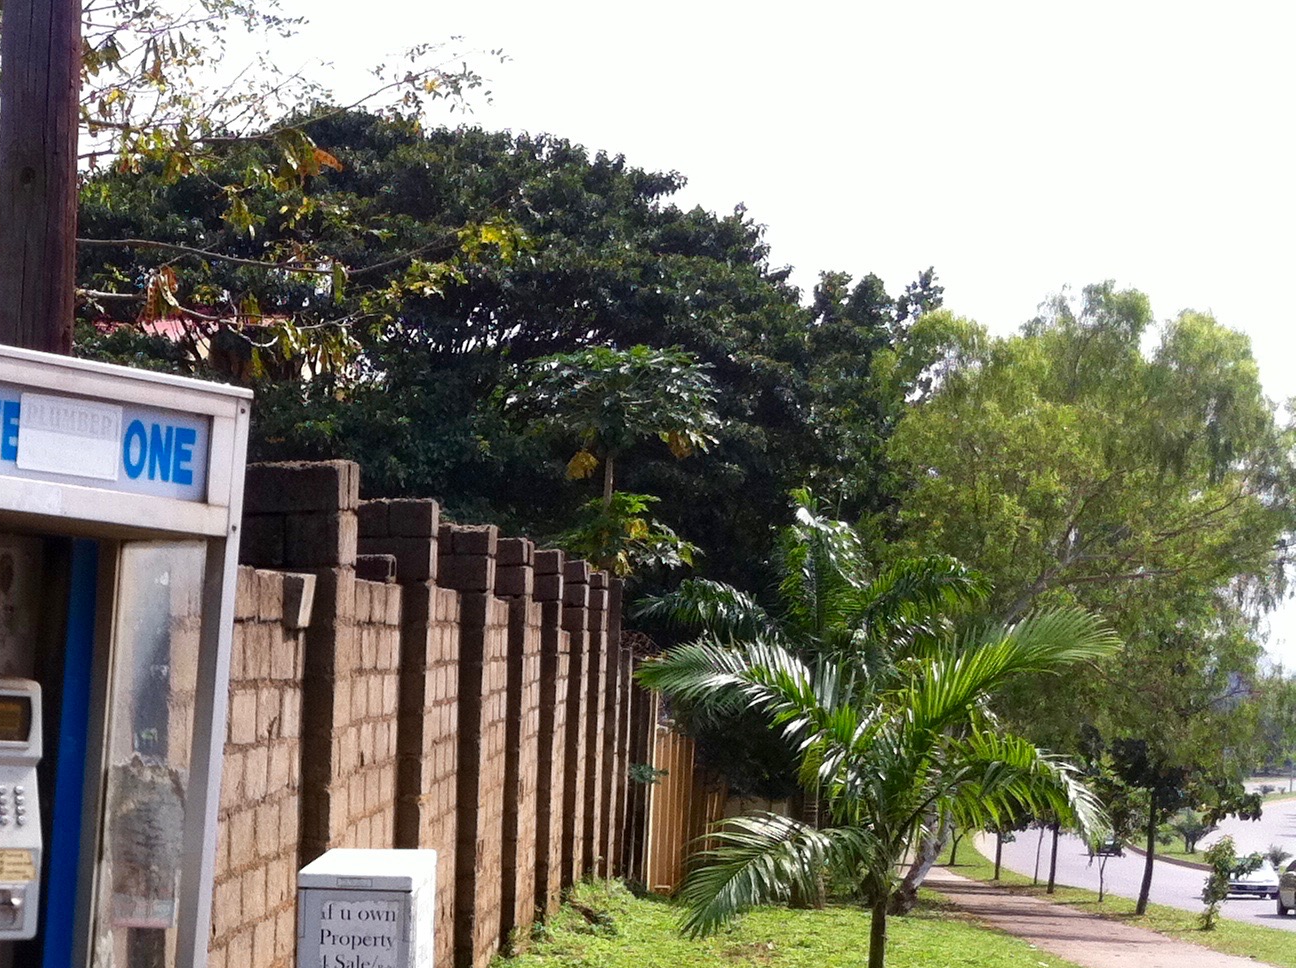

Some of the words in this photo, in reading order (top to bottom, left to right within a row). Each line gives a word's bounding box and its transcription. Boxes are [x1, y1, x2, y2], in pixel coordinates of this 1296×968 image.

[340, 909, 351, 921] u
[357, 909, 396, 922] own
[320, 928, 393, 951] Property
